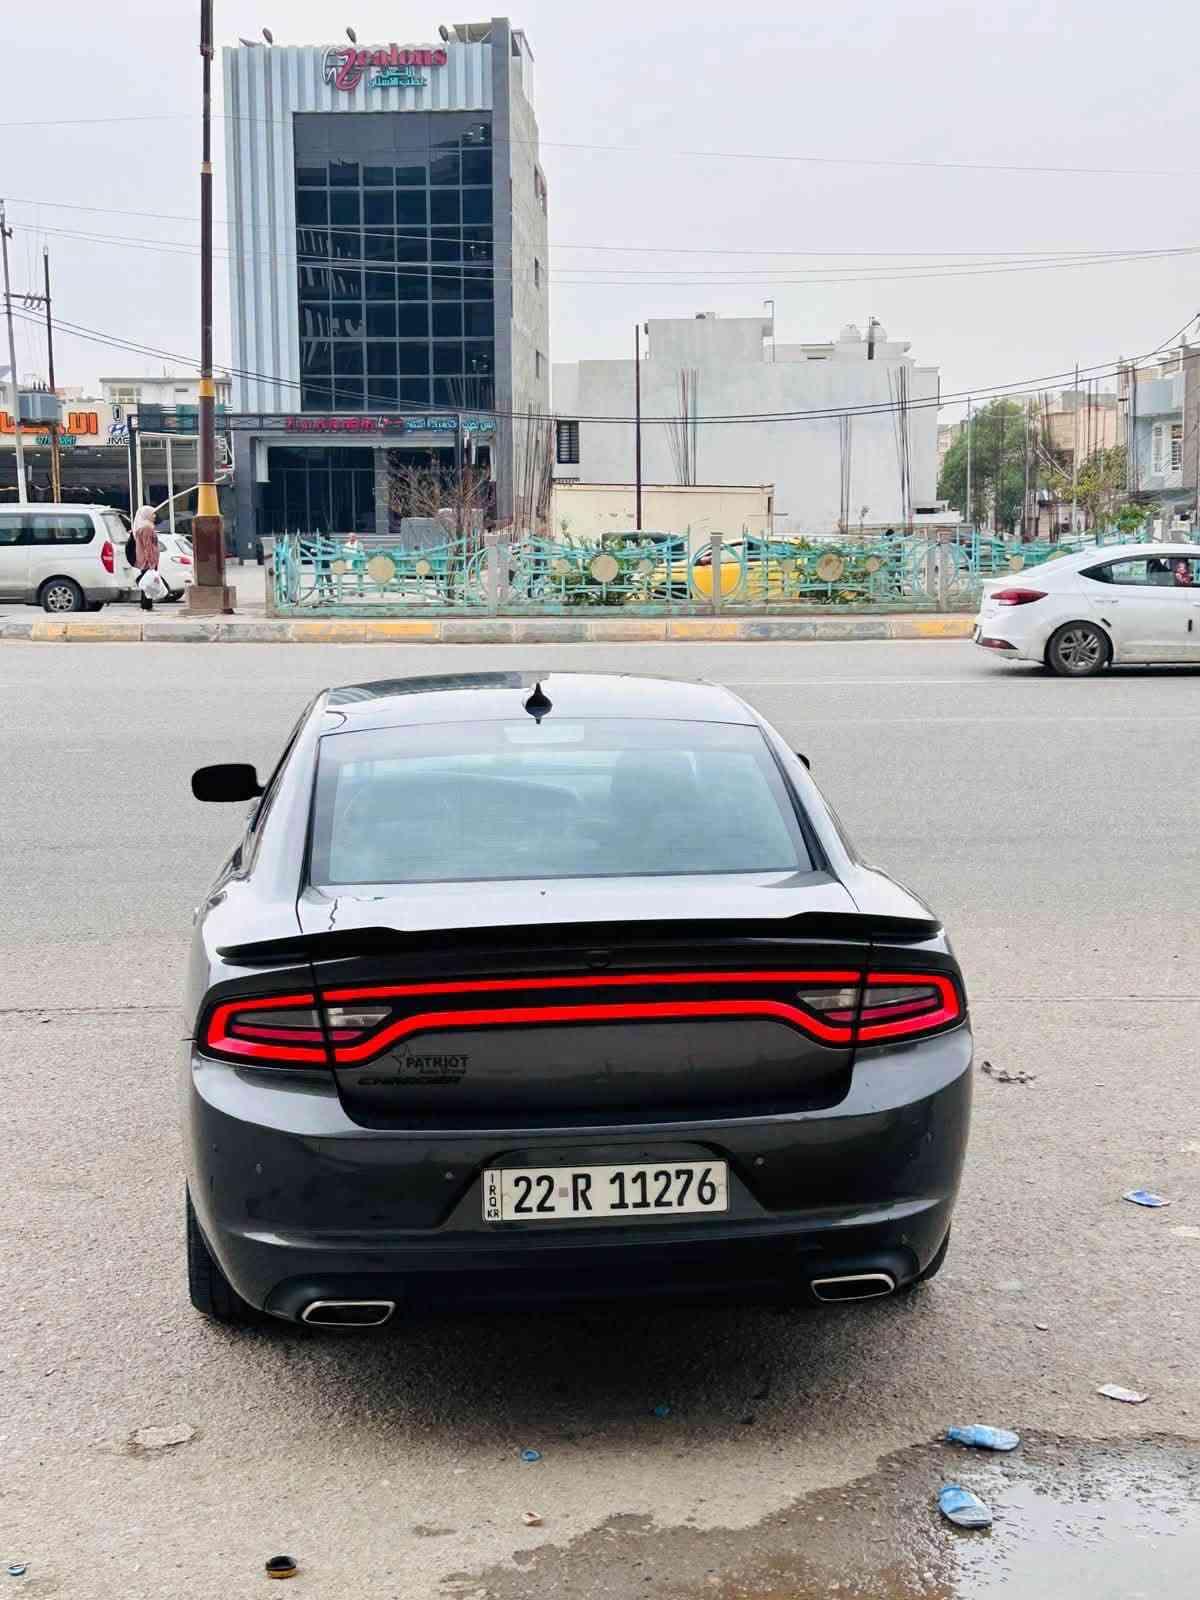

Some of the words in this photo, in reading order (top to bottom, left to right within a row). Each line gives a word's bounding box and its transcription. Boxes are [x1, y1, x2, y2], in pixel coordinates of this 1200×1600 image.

[406, 1056, 470, 1071] PATRIOT
[513, 1175, 555, 1213] 22
[572, 1173, 593, 1211] R
[609, 1168, 717, 1209] 11276
